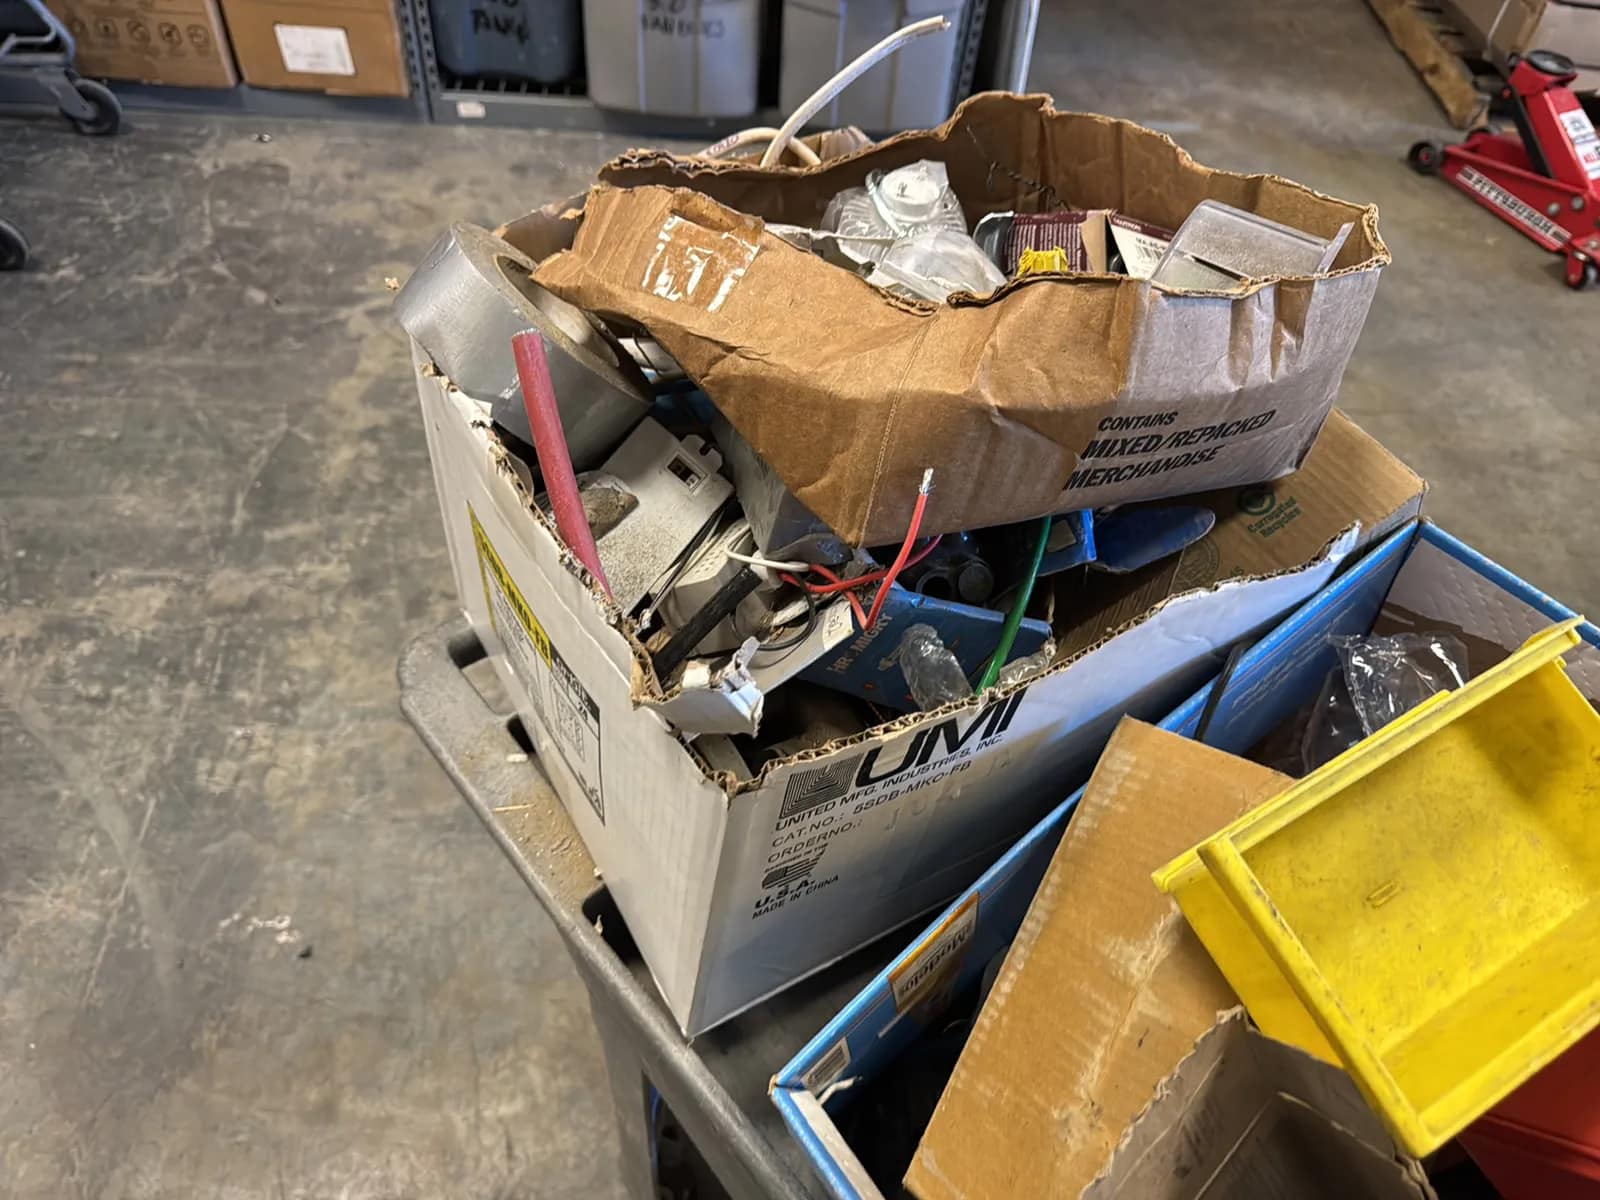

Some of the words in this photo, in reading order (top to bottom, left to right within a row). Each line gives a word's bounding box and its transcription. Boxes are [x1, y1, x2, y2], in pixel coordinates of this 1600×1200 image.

[1080, 409, 1277, 460] MIXED/REPACKED
[1098, 411, 1178, 432] CONTAINS
[1062, 445, 1225, 491] MERCHANDISE
[855, 687, 1029, 787] UMI
[775, 800, 837, 831] UNITED
[840, 785, 878, 806] MFG.
[752, 899, 786, 920] MADE
[790, 893, 801, 902] IN
[805, 875, 839, 896] CHINA
[755, 879, 816, 909] U.S.A.
[903, 920, 973, 992] Modelo
